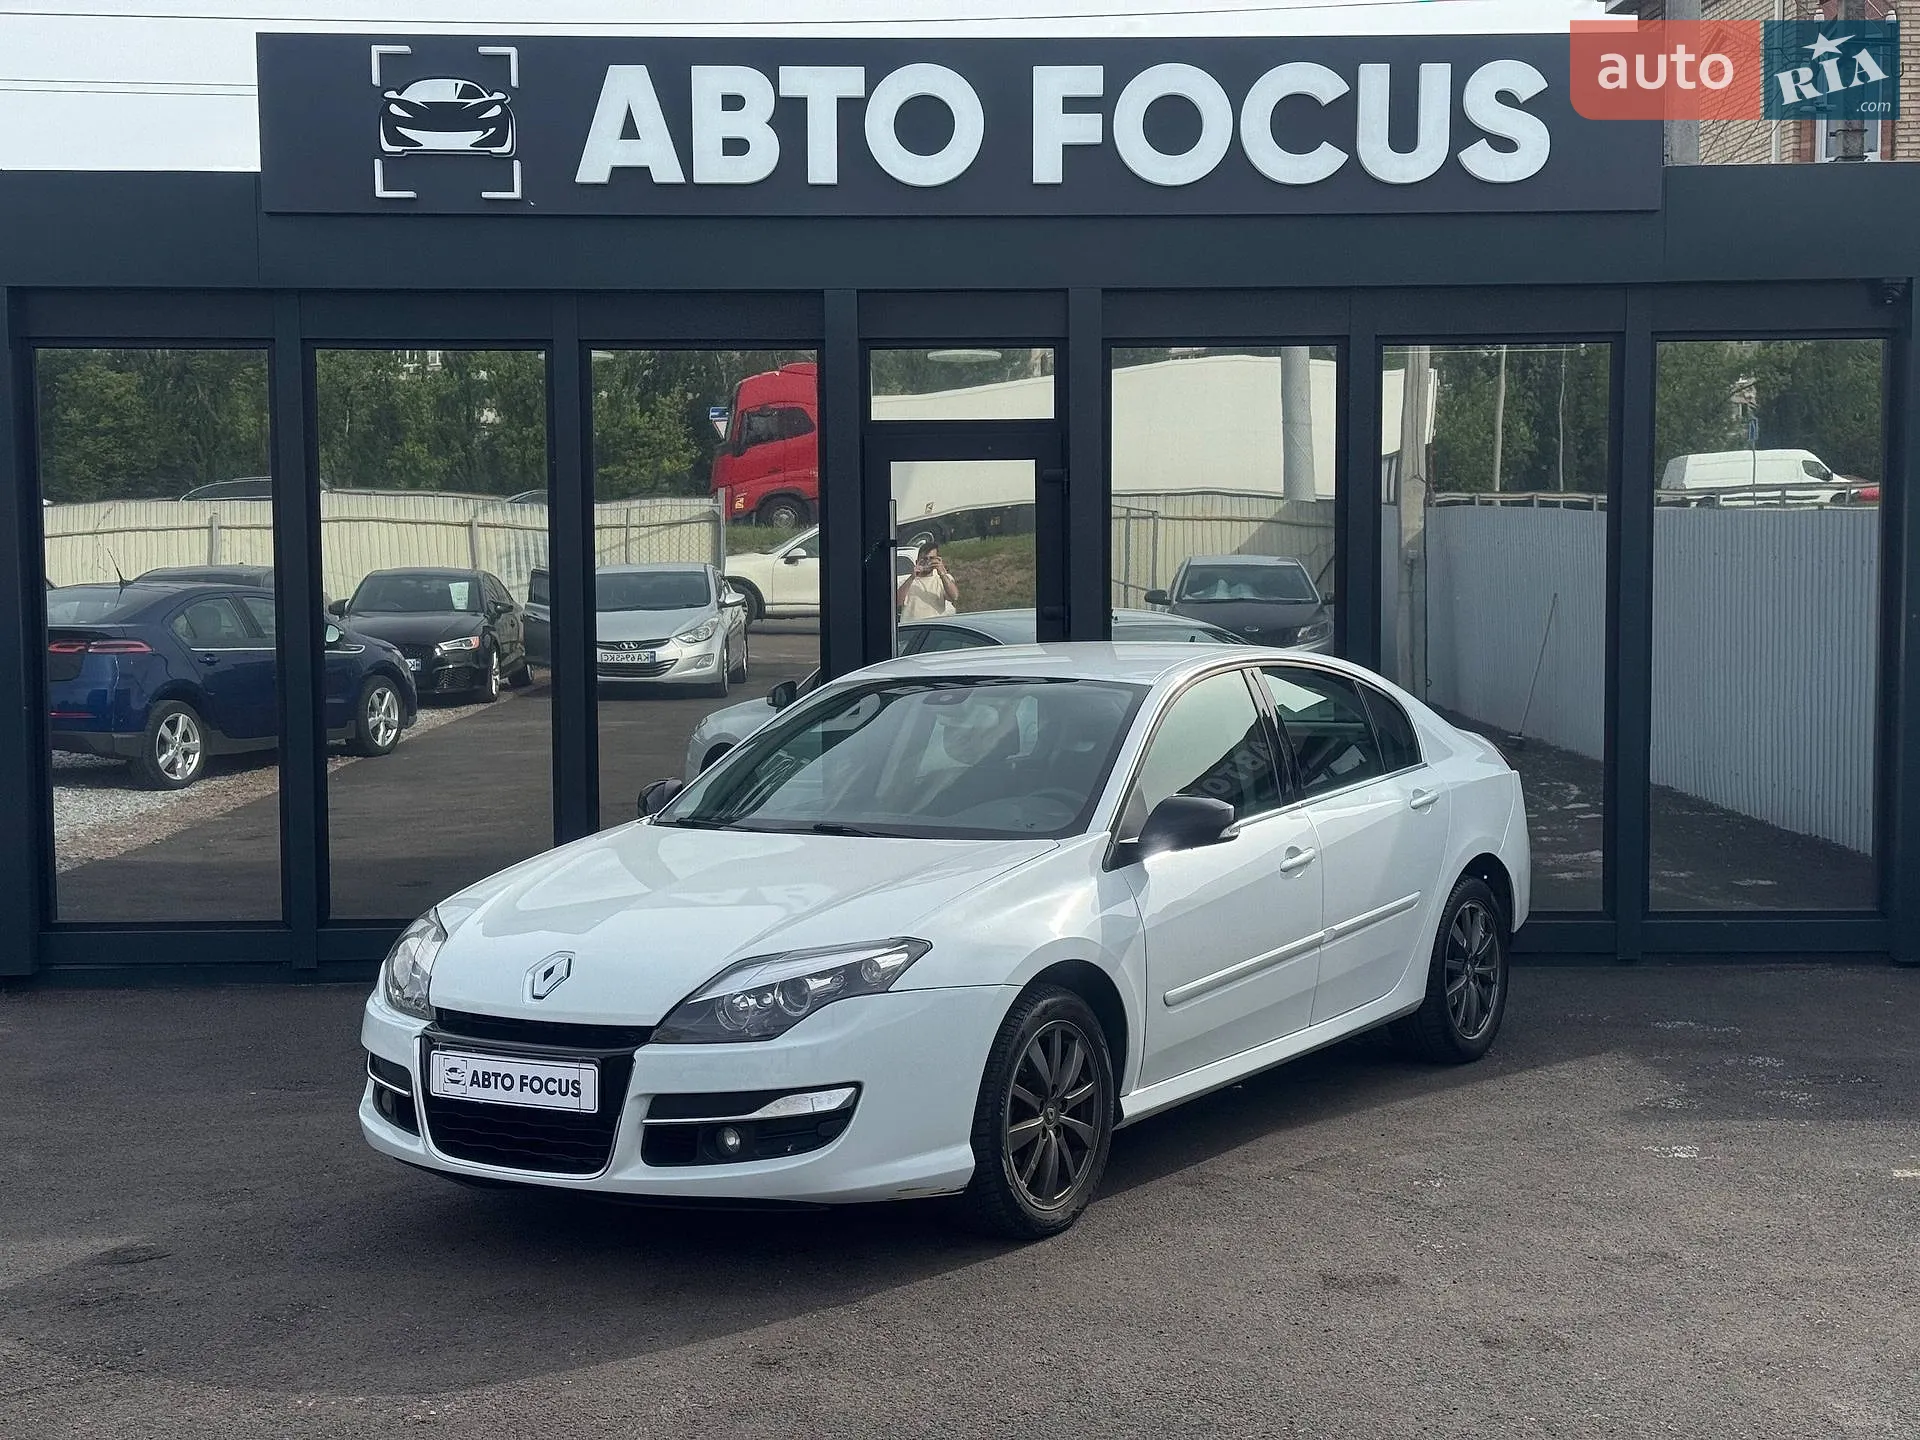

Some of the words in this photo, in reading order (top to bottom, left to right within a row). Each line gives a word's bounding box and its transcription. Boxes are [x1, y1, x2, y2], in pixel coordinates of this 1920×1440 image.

[575, 62, 985, 187] АВТО
[1032, 59, 1552, 187] FOCUS
[469, 1069, 515, 1092] АВТО
[519, 1074, 582, 1098] FOCUS
